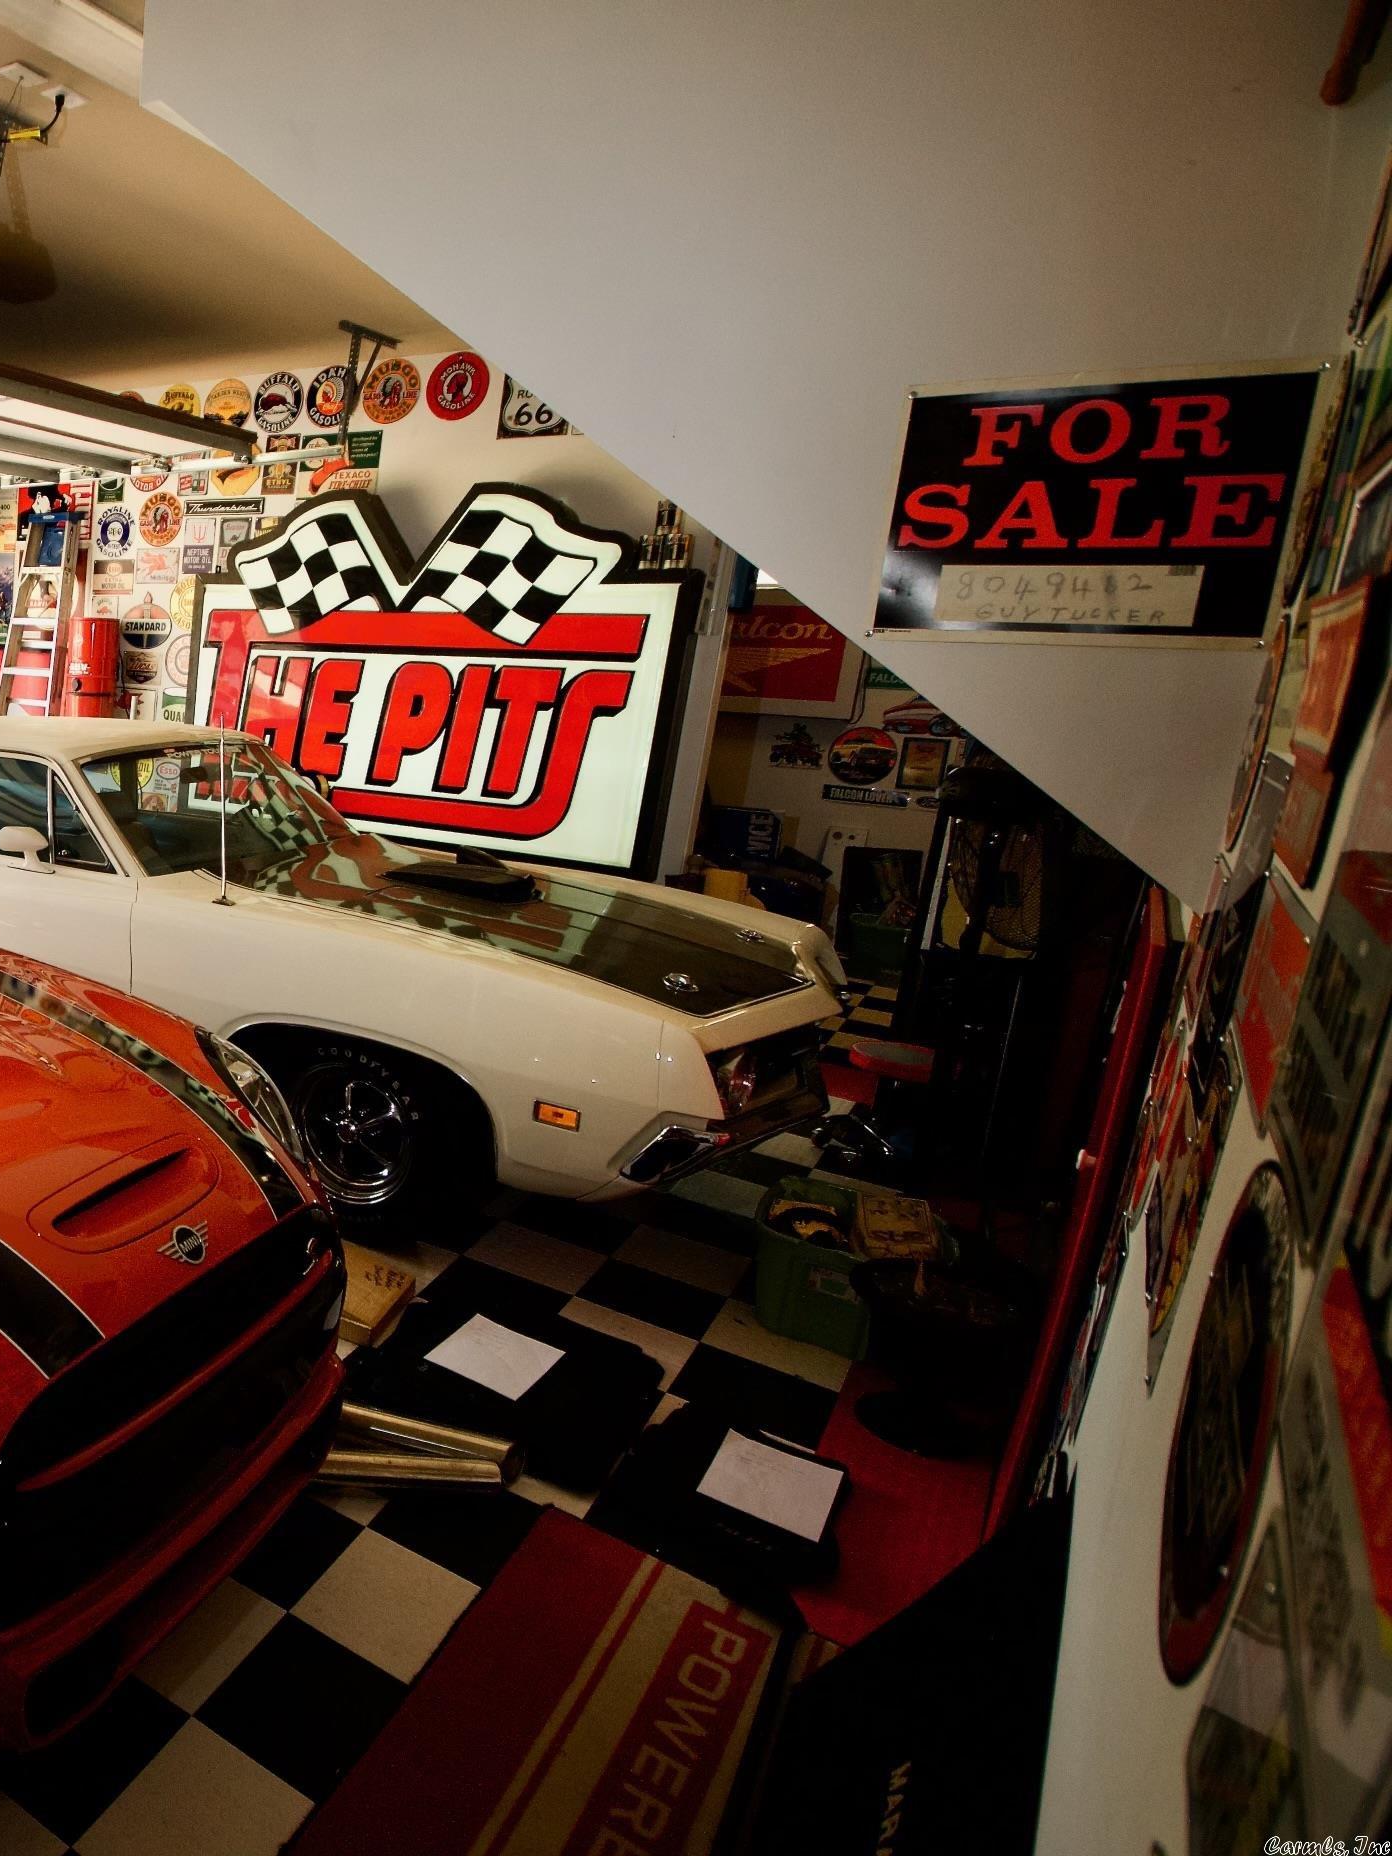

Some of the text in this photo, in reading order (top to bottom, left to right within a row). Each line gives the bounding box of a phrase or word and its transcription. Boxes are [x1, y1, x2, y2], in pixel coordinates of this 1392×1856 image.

[313, 367, 348, 388] IDAH
[440, 362, 476, 381] MOHAWK
[259, 374, 299, 395] BUFFALO
[164, 391, 195, 404] BUFFALO
[438, 392, 475, 410] GASOLINE
[257, 414, 296, 432] GASOLINE
[310, 408, 345, 426] GASOLI
[514, 402, 553, 426] 66
[962, 395, 1232, 467] FOR
[334, 470, 371, 479] TEXACO
[97, 506, 135, 526] ROYALINE
[188, 503, 258, 513] Thunderbird
[897, 474, 1287, 551] SALE
[96, 538, 133, 558] GASOLINE
[186, 548, 210, 556] NEPTUNE
[975, 605, 1166, 624] GUY TUCKER
[124, 621, 166, 631] STANDARD
[734, 614, 834, 641] alcon
[365, 660, 636, 840] PITS
[159, 765, 178, 775] ESSO
[829, 787, 863, 801] FALCON
[746, 813, 774, 856] VICE
[178, 1232, 200, 1254] MINI
